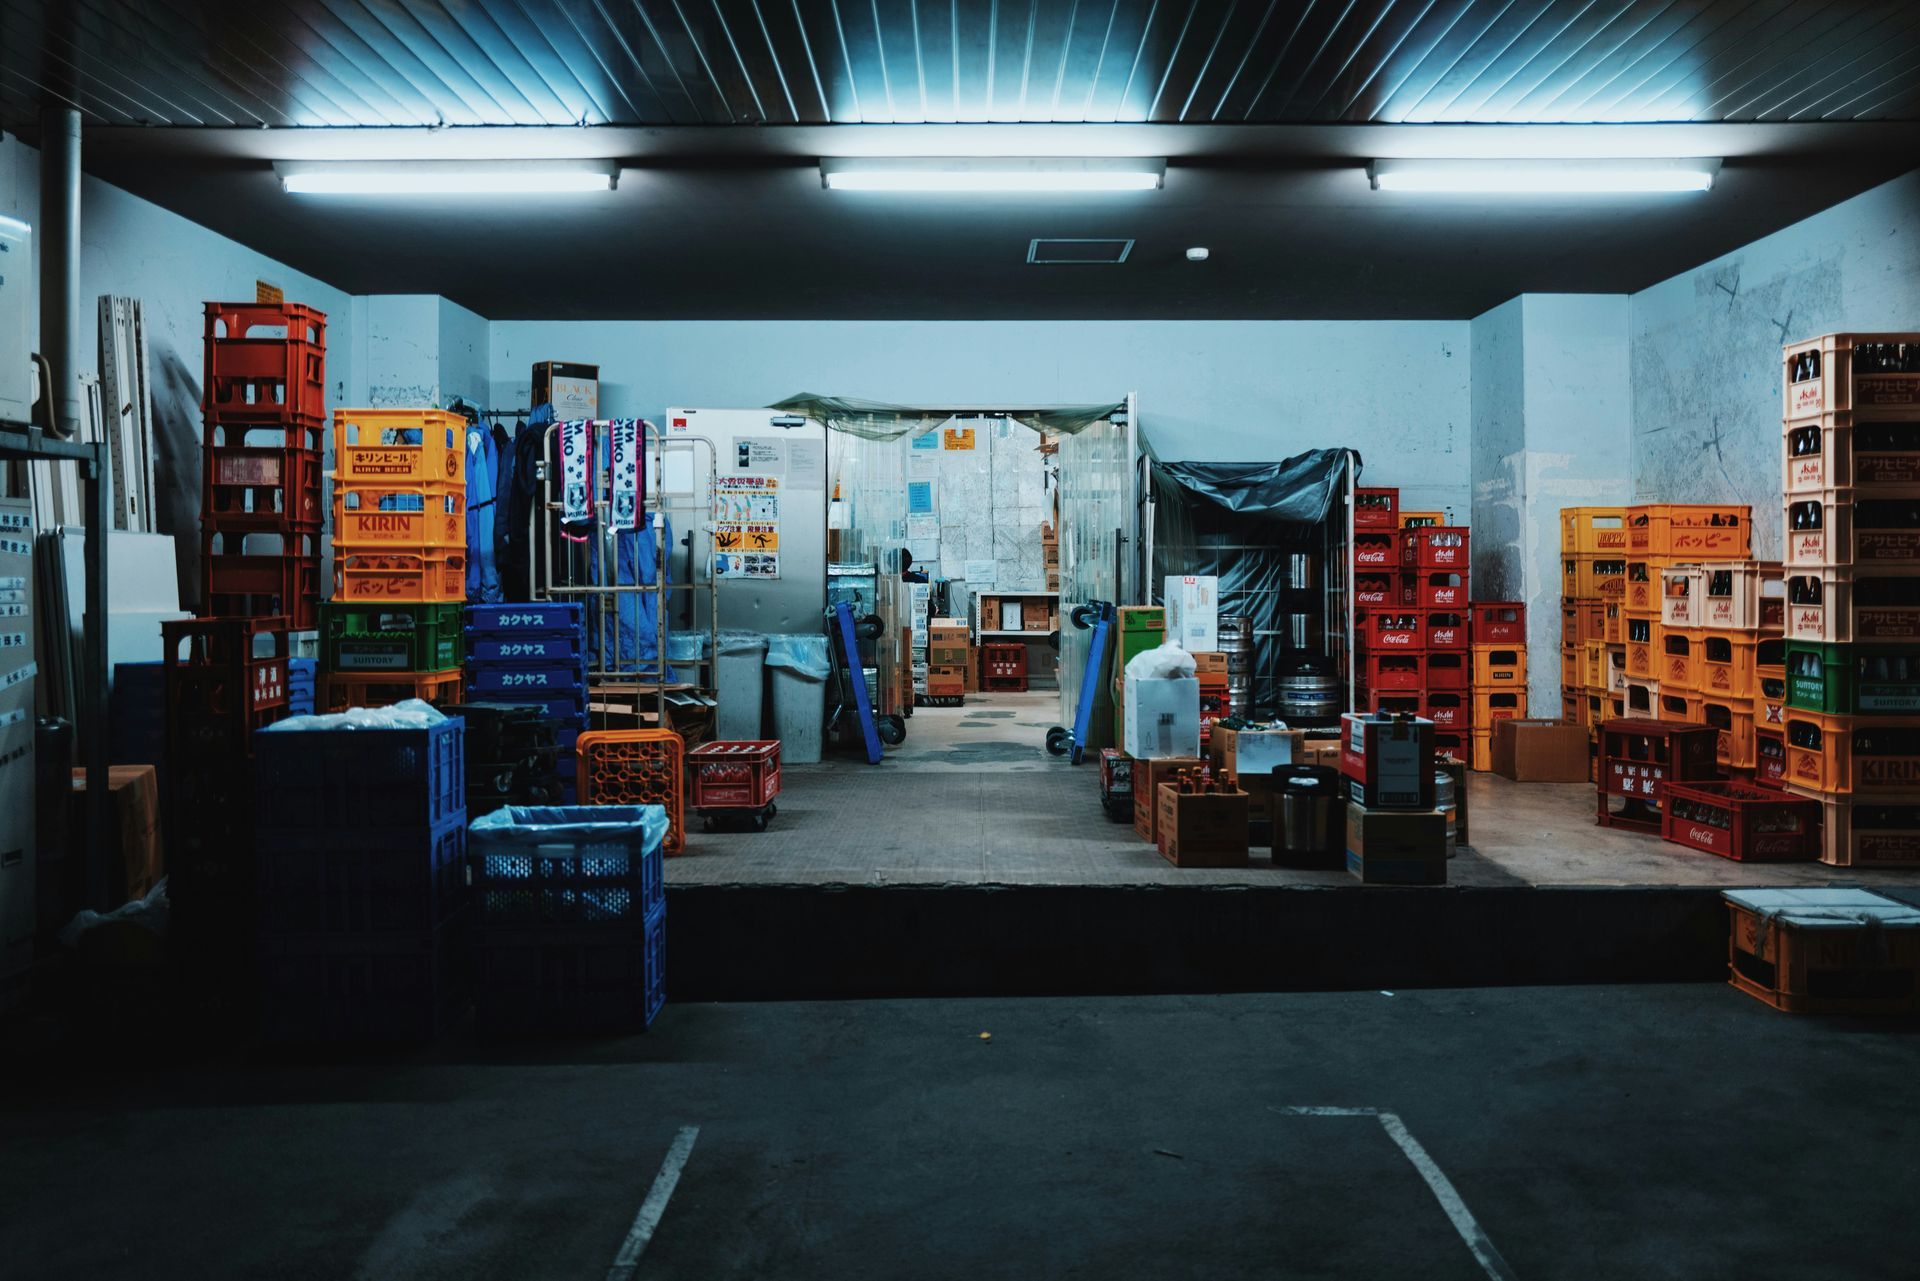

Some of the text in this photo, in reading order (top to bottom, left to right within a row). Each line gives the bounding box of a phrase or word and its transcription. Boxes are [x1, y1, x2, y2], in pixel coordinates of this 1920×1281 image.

[354, 453, 409, 463] キリンビール
[358, 516, 411, 532] KIRIN
[1599, 532, 1625, 543] HOPPY
[1675, 532, 1732, 548] ホッピー
[1802, 535, 1820, 548] Asahi
[1435, 549, 1455, 558] Asahi
[353, 576, 416, 594] ホッピー
[1435, 590, 1455, 599] Asahi
[498, 614, 545, 626] カクヤス
[1802, 610, 1820, 623] Asahi
[1434, 630, 1454, 639] Asahi
[500, 644, 546, 656] カクヤス
[353, 656, 394, 665] SUNTORY
[502, 674, 549, 686] カクヤス
[1796, 680, 1824, 692] SUNTORY
[1873, 699, 1918, 707] SUNTORY
[1434, 710, 1454, 719] Asahi
